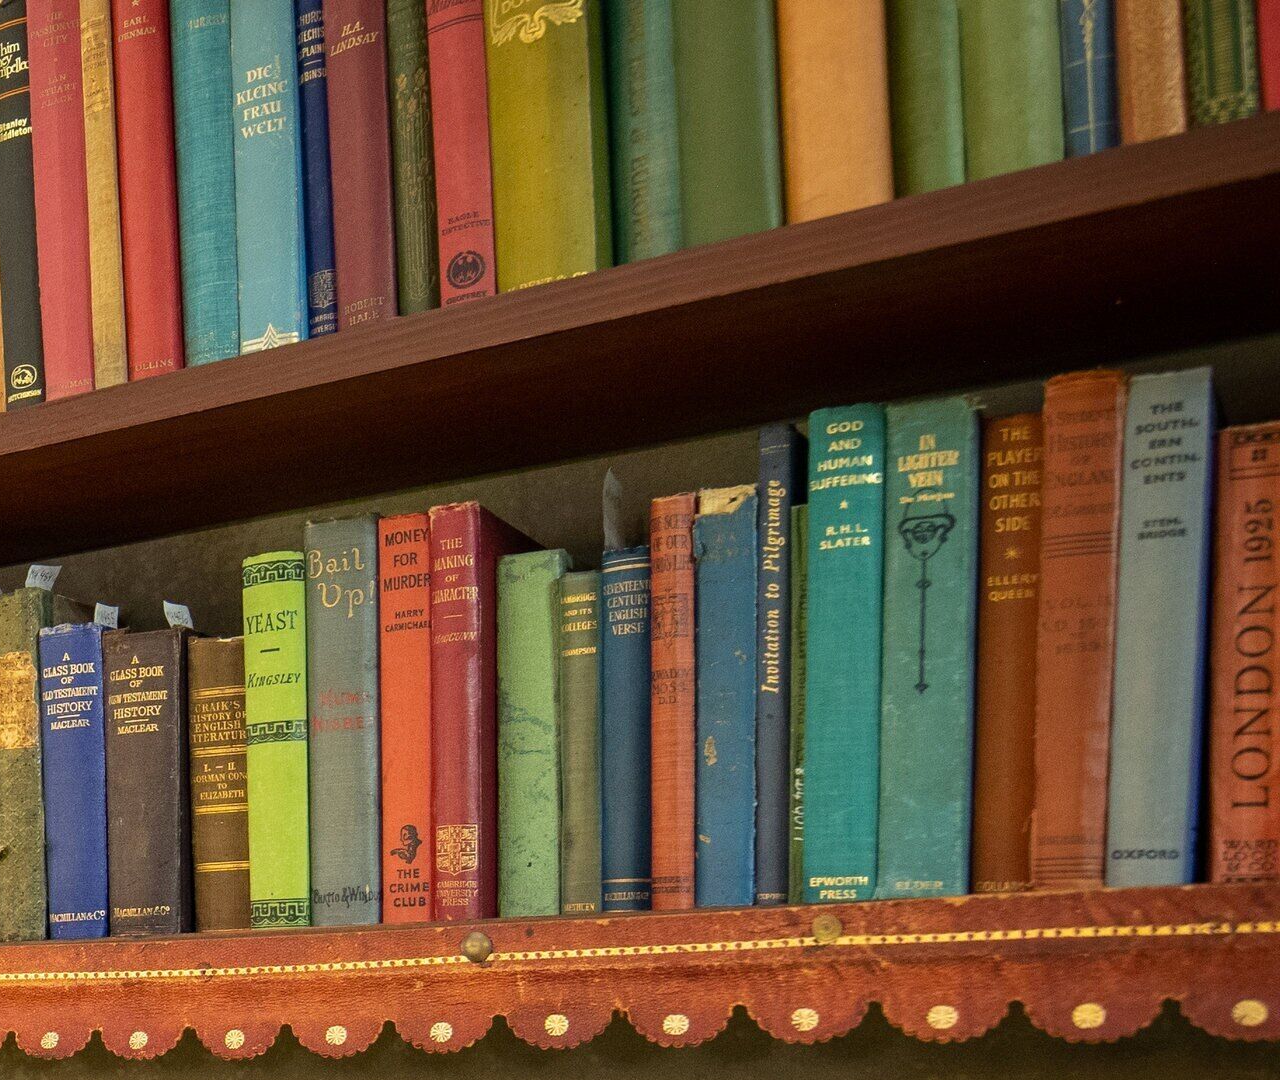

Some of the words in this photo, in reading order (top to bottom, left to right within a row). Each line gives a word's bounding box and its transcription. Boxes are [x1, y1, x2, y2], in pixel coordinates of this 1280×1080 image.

[123, 15, 148, 28] EARL
[0, 41, 20, 57] him
[330, 30, 379, 58] LINDSAY
[246, 63, 272, 84] DIE
[236, 78, 289, 106] KLEINE
[242, 99, 282, 122] FRAU
[240, 116, 287, 140] WELT
[343, 295, 385, 315] ROBERT
[349, 310, 380, 327] HALE
[1150, 401, 1184, 416] THE
[825, 420, 864, 435] GOD
[999, 427, 1031, 442] THE
[827, 437, 862, 453] AND
[816, 454, 874, 472] HUMAN
[809, 472, 883, 492] SUFFERING
[1143, 470, 1187, 486] ENTS
[763, 479, 787, 574] Pilgrimage
[994, 515, 1032, 532] SIDE
[384, 527, 430, 548] MONEY
[1136, 526, 1189, 541] BRIDGE
[440, 537, 463, 550] THE
[818, 535, 871, 550] SLATER
[393, 551, 418, 567] FOR
[383, 572, 431, 592] MURDER
[766, 576, 779, 602] to
[988, 588, 1036, 602] QUEEN
[394, 608, 425, 620] HARRY
[246, 610, 298, 635] YEAST
[612, 622, 645, 636] VERSE
[761, 609, 780, 694] Invitation
[42, 664, 68, 679] CLASS
[69, 662, 96, 677] BOOK
[109, 669, 136, 681] CLASS
[138, 666, 165, 678] BOOK
[246, 671, 302, 689] KINGSLEY
[46, 700, 94, 716] HISTORY
[113, 705, 162, 717] HISTORY
[50, 718, 91, 731] MACLEAR
[117, 723, 160, 735] MACLEAR
[1110, 848, 1180, 861] OXFORD
[396, 868, 420, 880] THE
[809, 875, 870, 889] EPWORTH
[389, 882, 430, 894] CRIME
[819, 888, 858, 901] PRESS
[393, 896, 426, 908] CLUB
